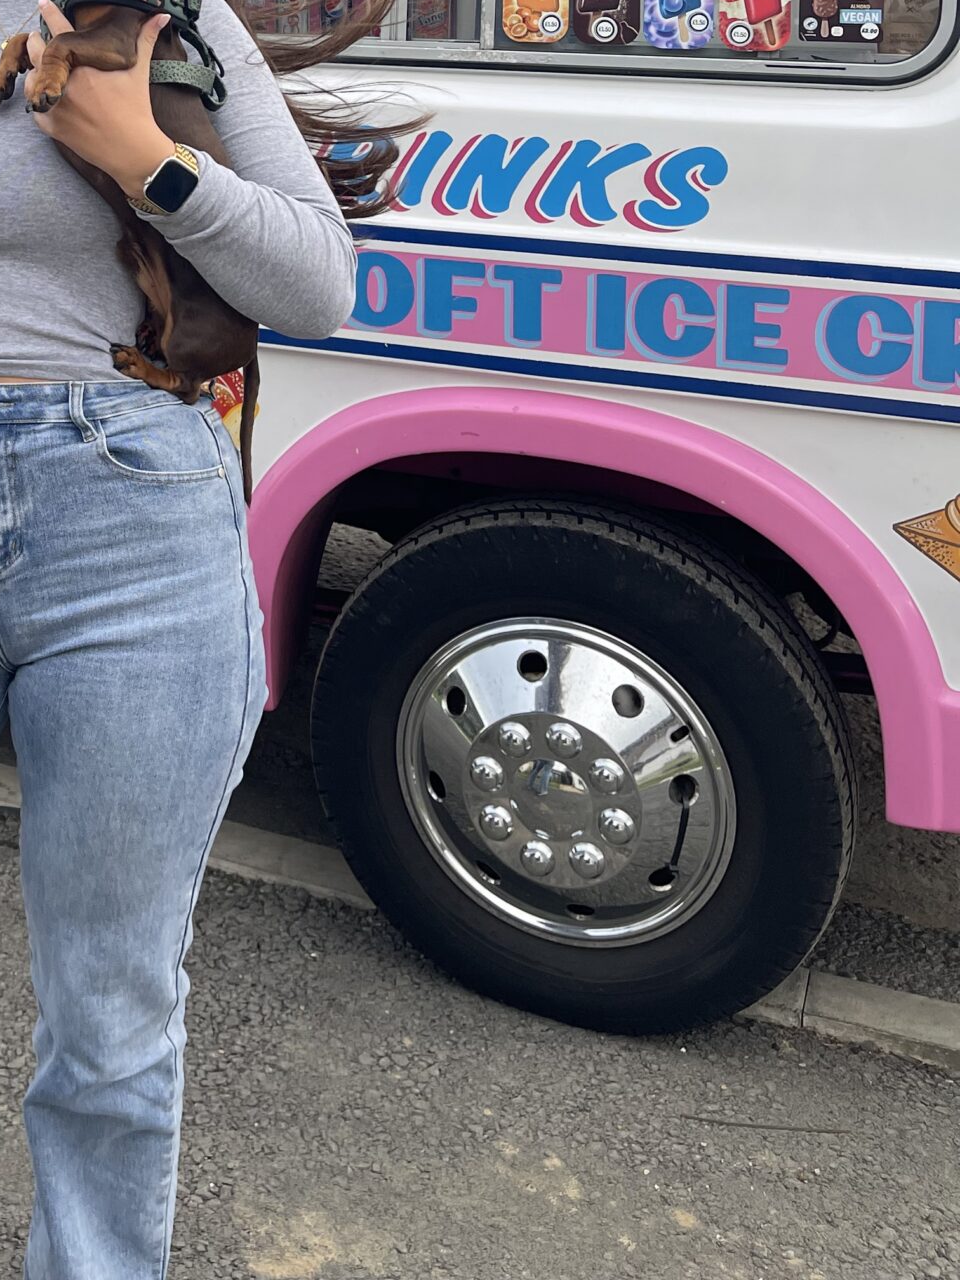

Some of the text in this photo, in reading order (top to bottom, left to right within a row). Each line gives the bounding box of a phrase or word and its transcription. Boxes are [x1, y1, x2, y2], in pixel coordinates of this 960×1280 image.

[841, 11, 880, 22] VEGAN
[345, 250, 563, 349] OFT
[586, 273, 791, 373] ICE
